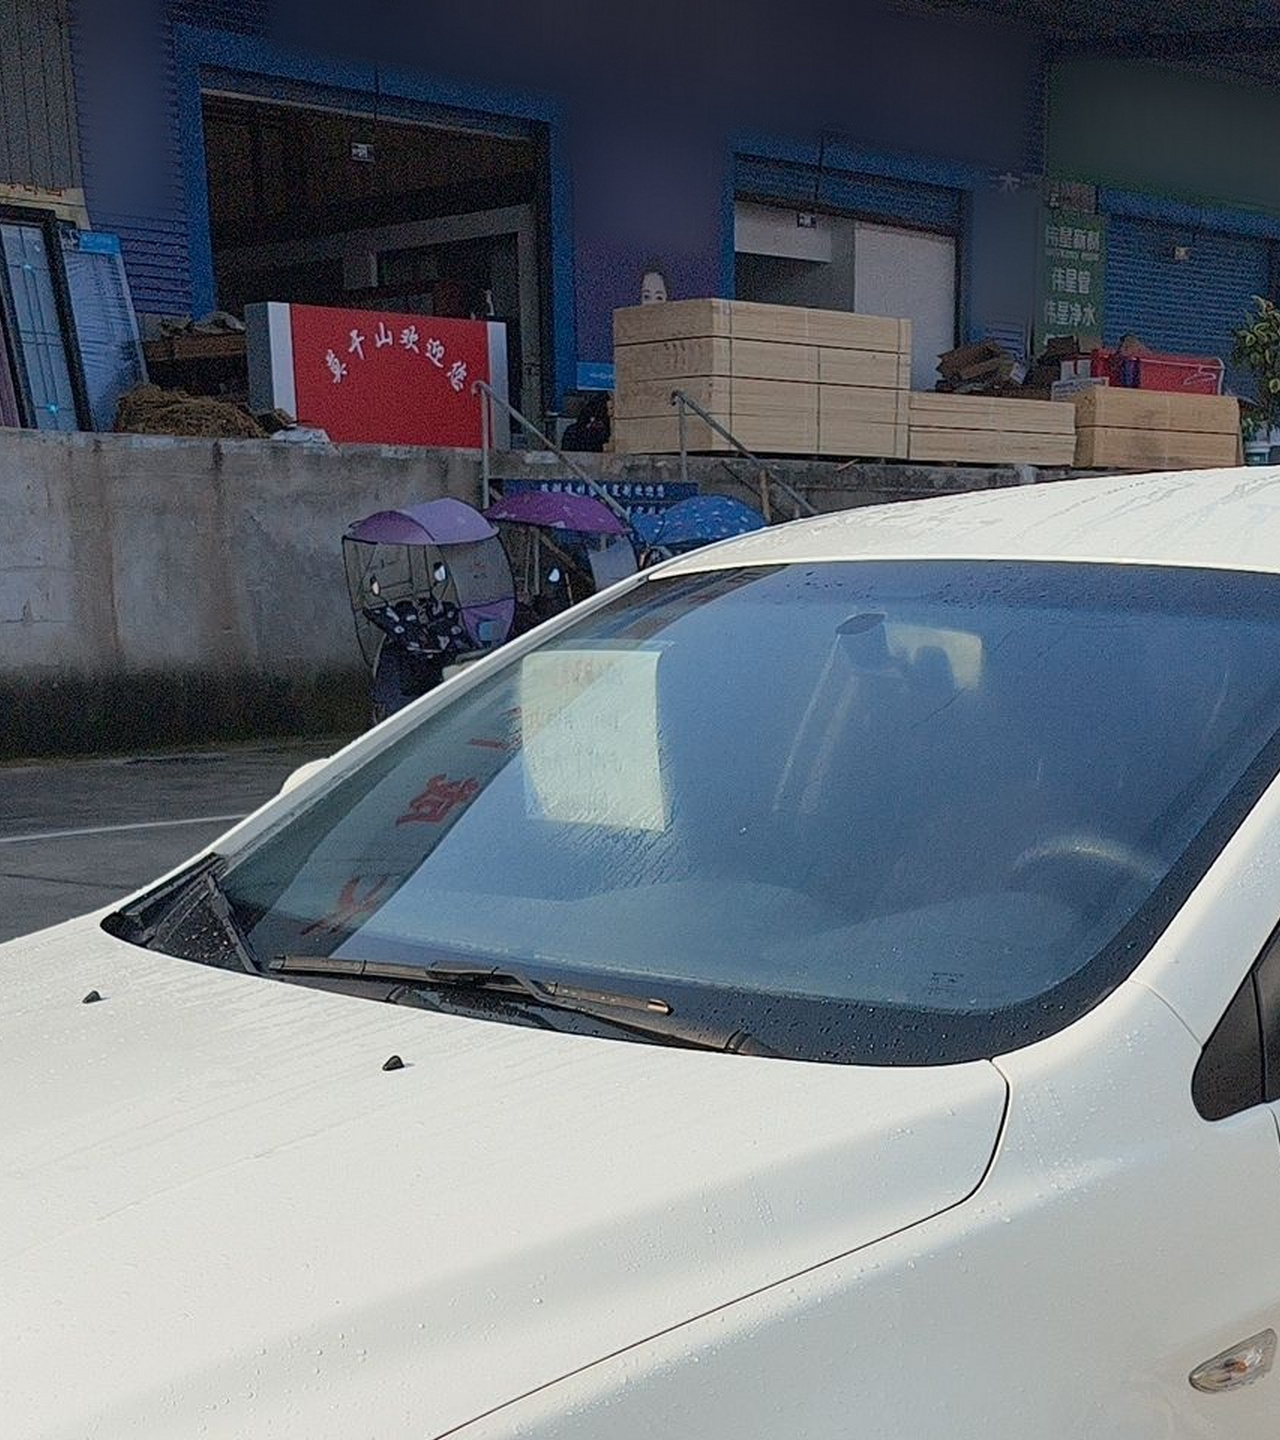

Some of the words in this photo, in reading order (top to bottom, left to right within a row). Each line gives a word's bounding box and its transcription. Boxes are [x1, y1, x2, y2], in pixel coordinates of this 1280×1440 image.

[1051, 266, 1091, 295] 伟星管
[325, 321, 468, 392] 莫干山欢迎您
